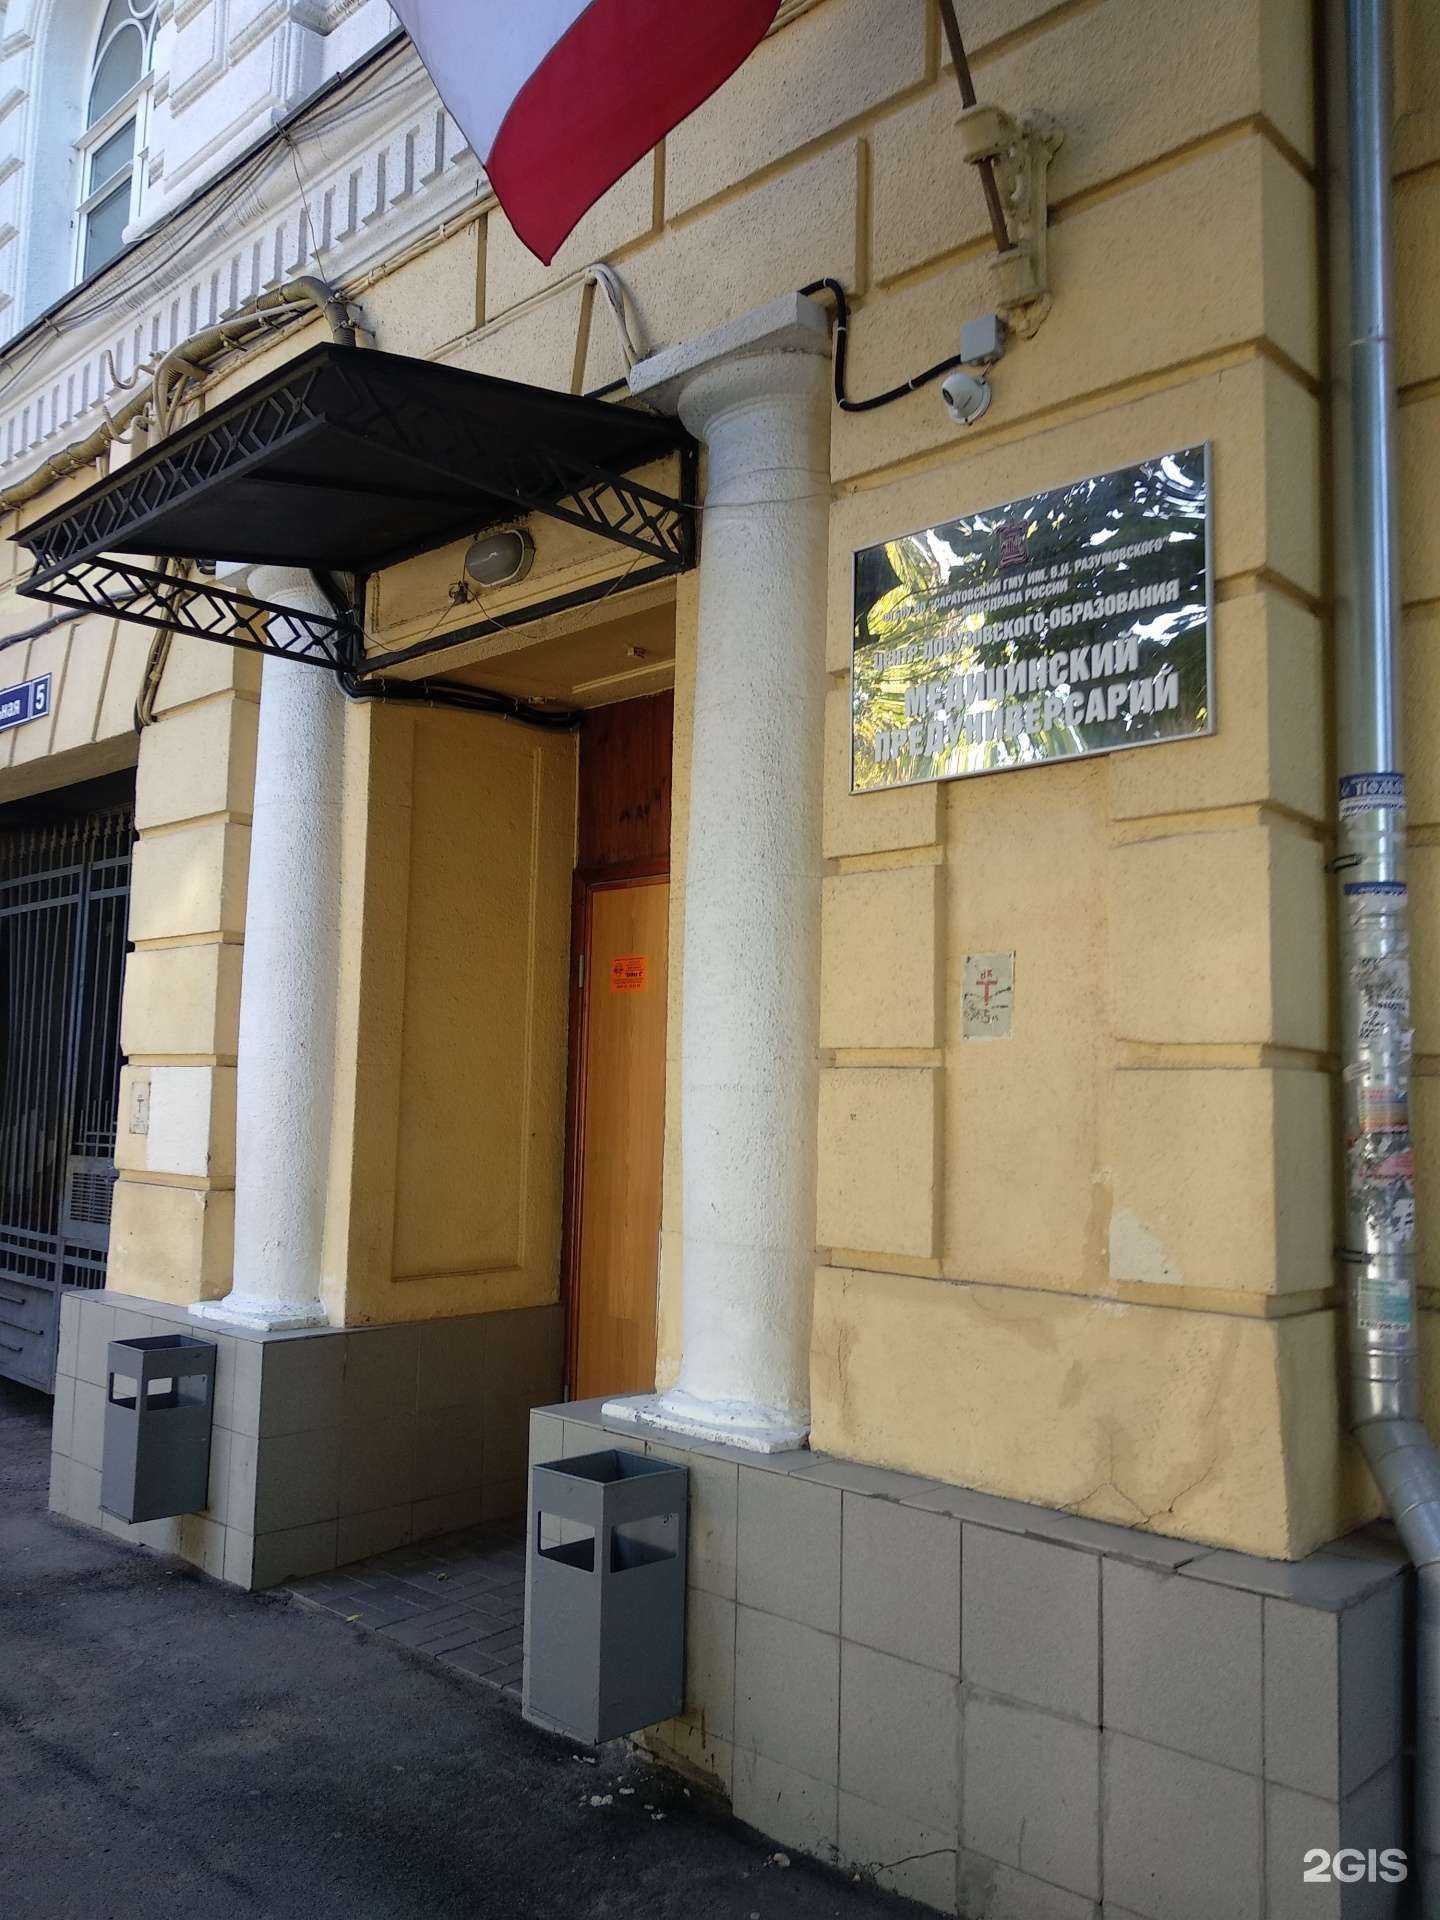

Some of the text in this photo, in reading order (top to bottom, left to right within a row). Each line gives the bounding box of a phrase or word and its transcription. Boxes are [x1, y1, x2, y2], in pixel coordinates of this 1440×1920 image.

[962, 578, 1068, 618] МИНЗДРАВА РОССИИ
[1003, 573, 1024, 591] ГМУ
[1027, 568, 1047, 585] ИМ.
[874, 577, 1180, 672] ЦЕНТР ДОВУЗОВСКОГО ОБРАЗОВАНИЯ
[904, 631, 1139, 718] МЕДИЦИНСКИЙ
[0, 700, 20, 720] ная
[36, 684, 45, 709] 5
[874, 664, 1179, 762] ПРЕДУНИВЕРСАРИЙ
